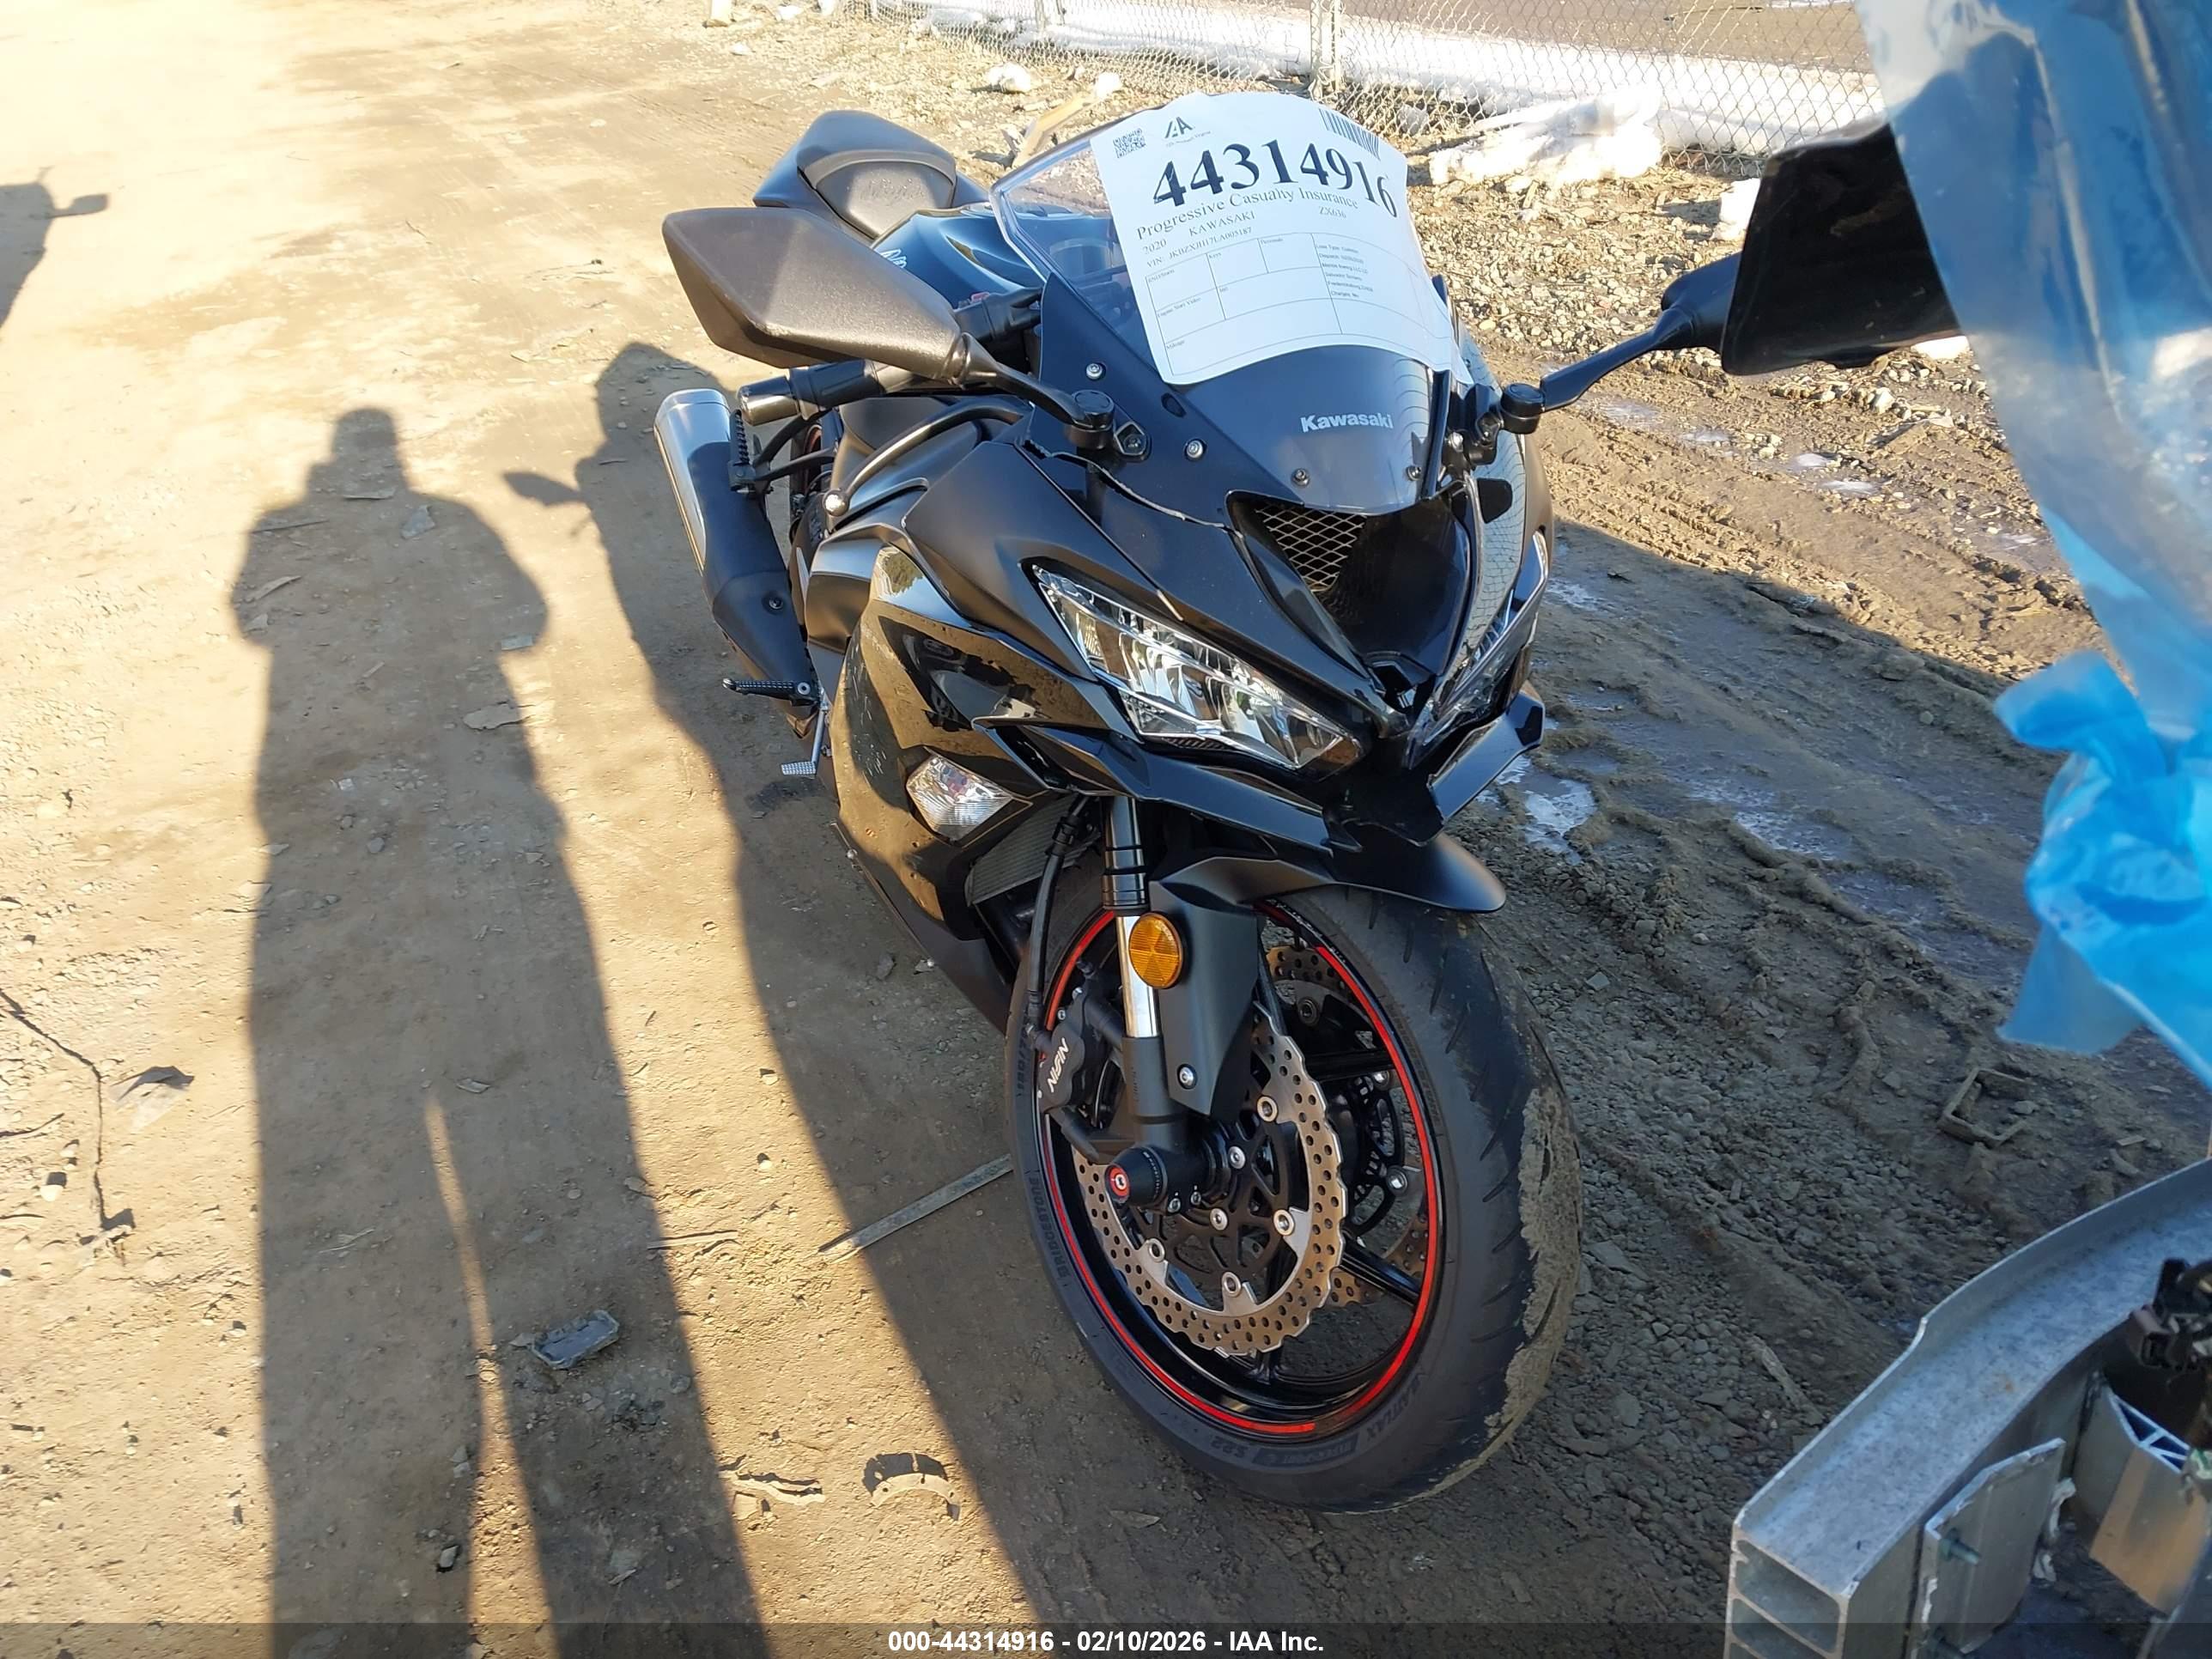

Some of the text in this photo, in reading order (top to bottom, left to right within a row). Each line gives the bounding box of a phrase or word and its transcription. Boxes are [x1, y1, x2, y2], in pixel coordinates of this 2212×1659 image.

[1152, 138, 1398, 218] 44314916
[1136, 187, 1359, 240] Progressive Casualty Insurance
[1143, 239, 1167, 255] 2020
[1189, 210, 1255, 237] KAWASAKI
[1299, 413, 1395, 433] Kawasaki
[1047, 1037, 1069, 1093] NISSIN
